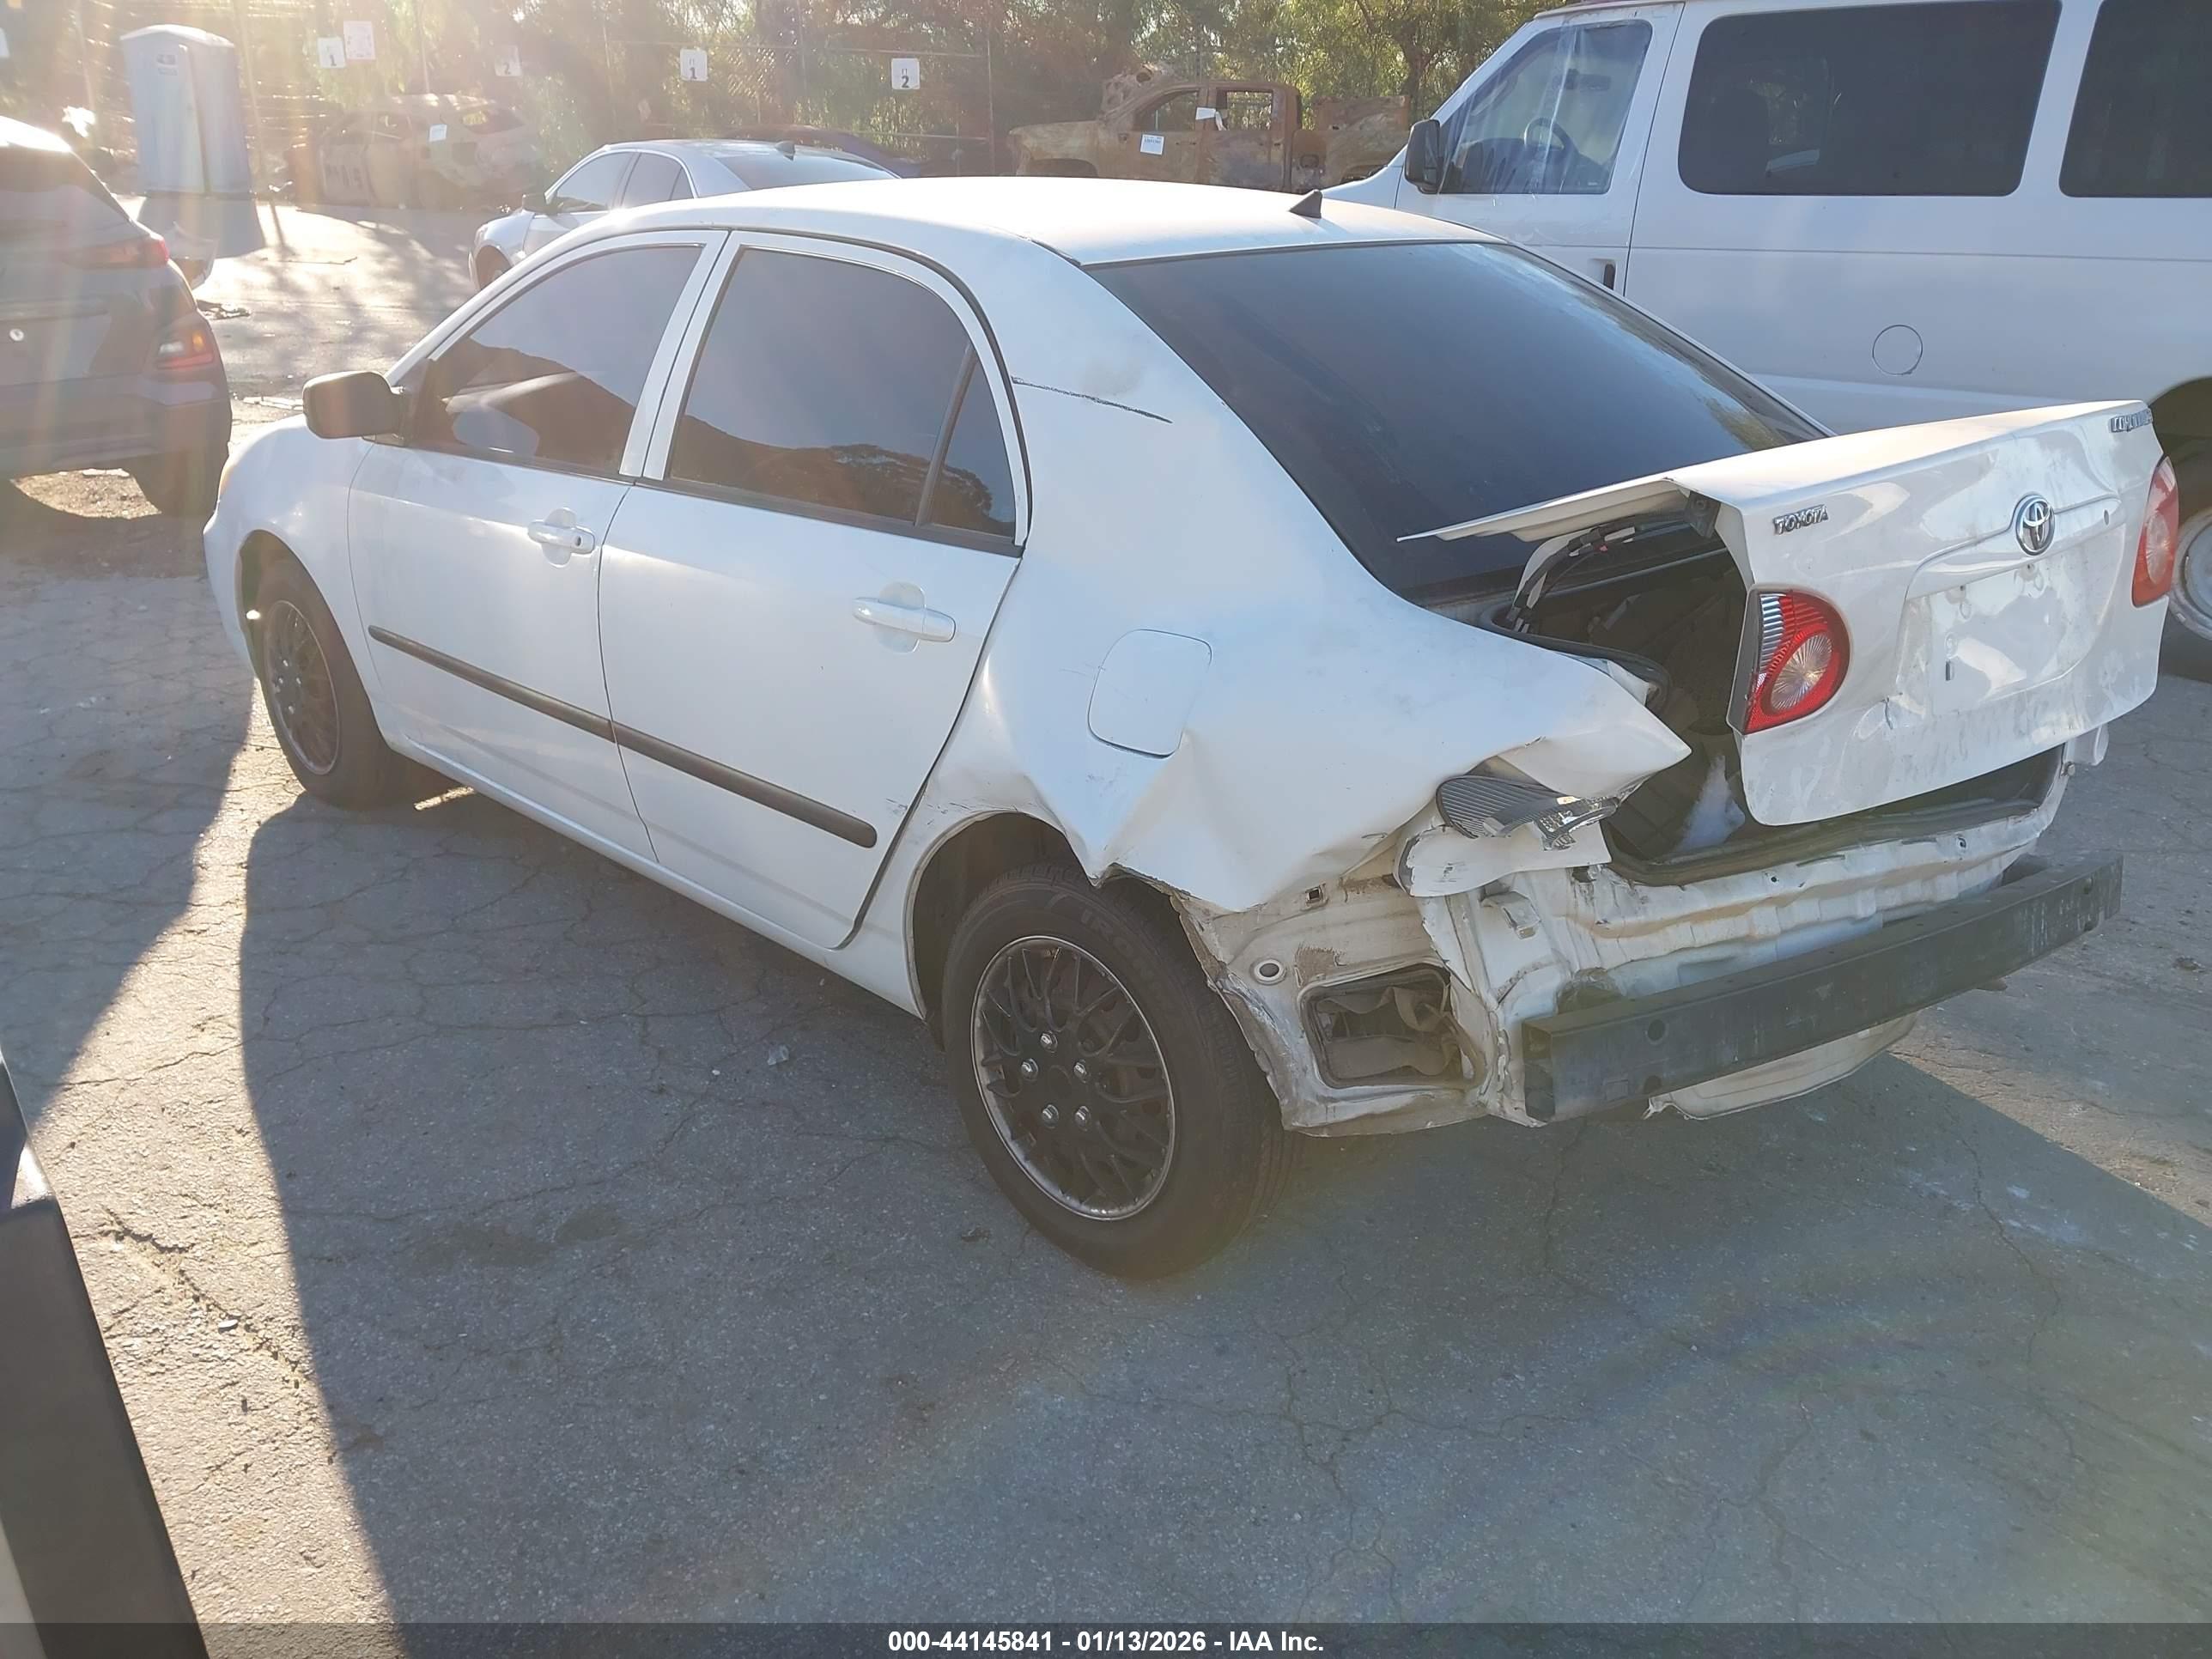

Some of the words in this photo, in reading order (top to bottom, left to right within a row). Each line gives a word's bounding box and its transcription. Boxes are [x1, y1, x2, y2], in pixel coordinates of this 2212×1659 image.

[690, 67, 697, 80] 1
[901, 75, 910, 88] 2
[1772, 503, 1829, 535] TOYOTA
